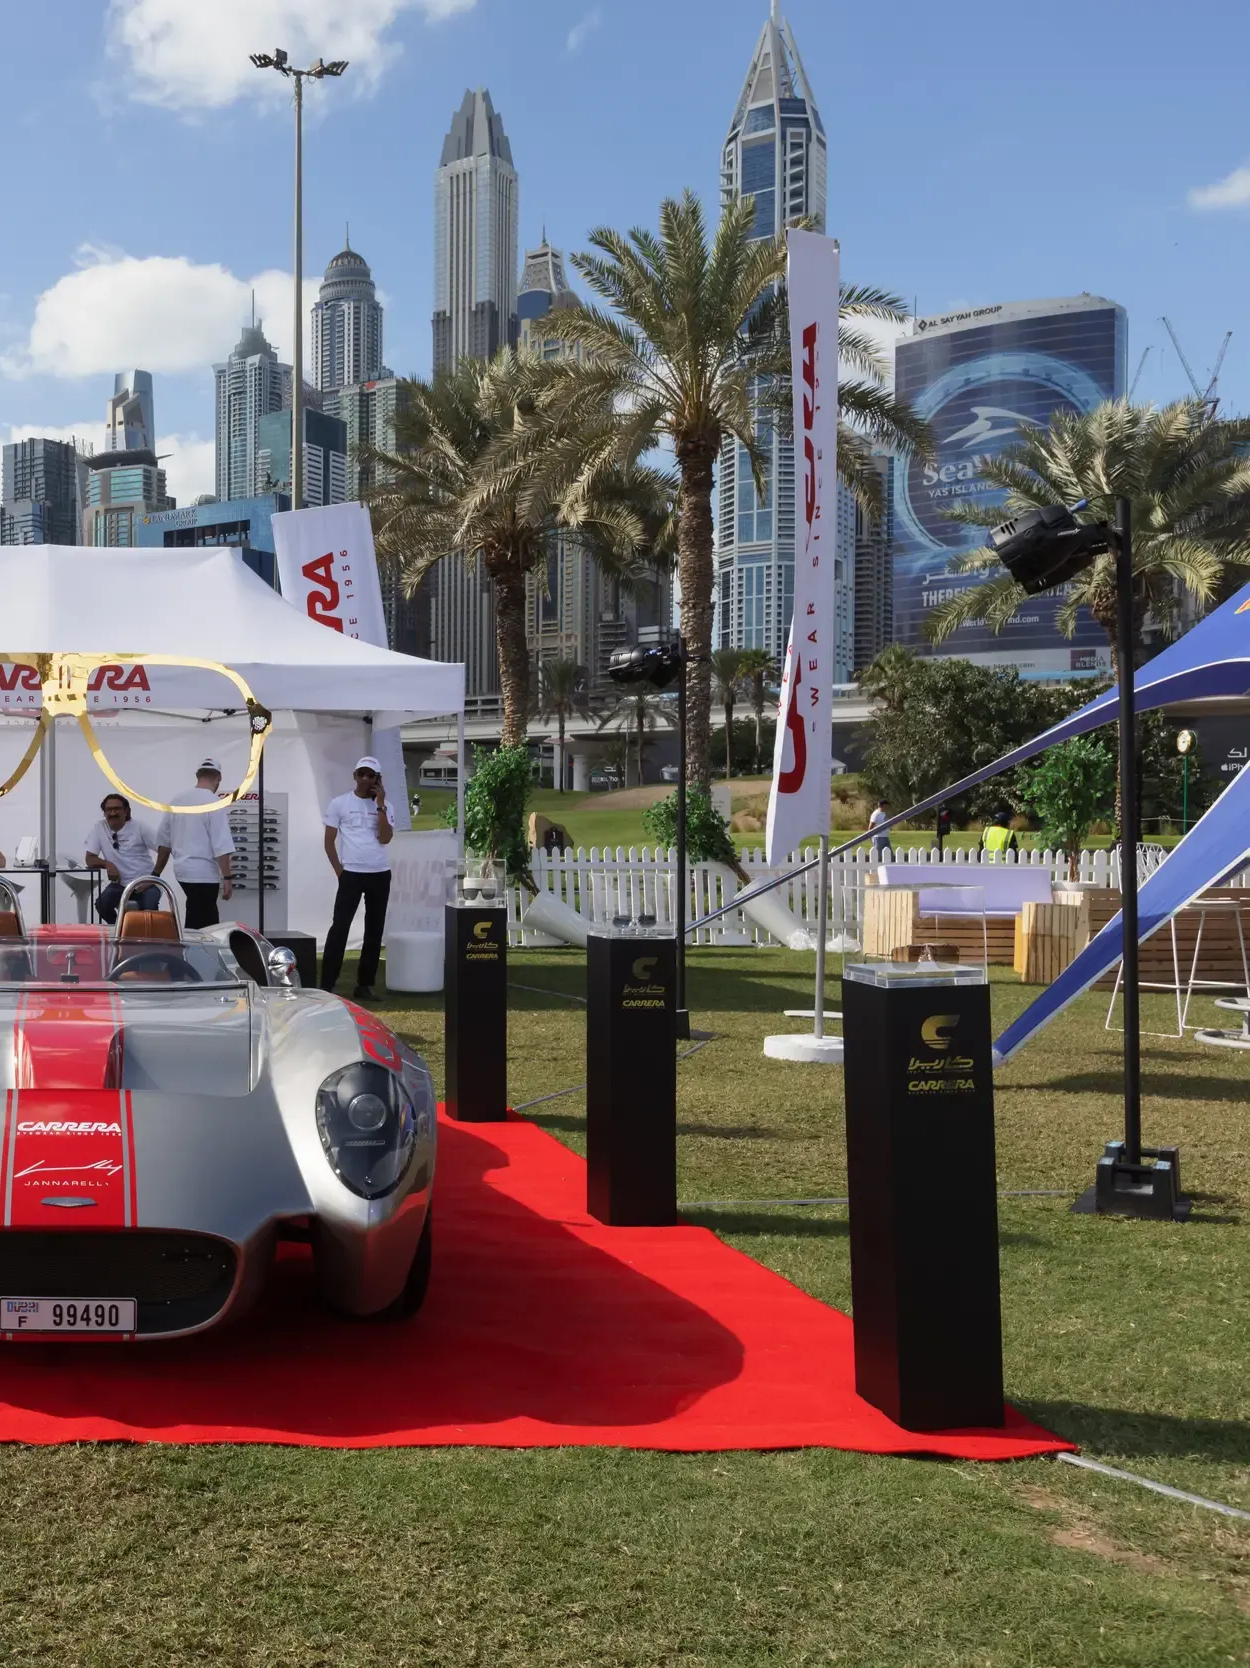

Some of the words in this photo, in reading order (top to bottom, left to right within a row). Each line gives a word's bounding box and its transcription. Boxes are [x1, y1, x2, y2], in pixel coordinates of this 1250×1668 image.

[928, 320, 938, 329] AL
[972, 305, 1003, 318] GROUP
[928, 486, 949, 498] YAS
[339, 550, 355, 599] 1956
[113, 695, 152, 703] 1956
[908, 1080, 975, 1091] CARRERA
[17, 1121, 122, 1132] CARRERA
[52, 1304, 119, 1327] 99490
[18, 1316, 28, 1328] F
